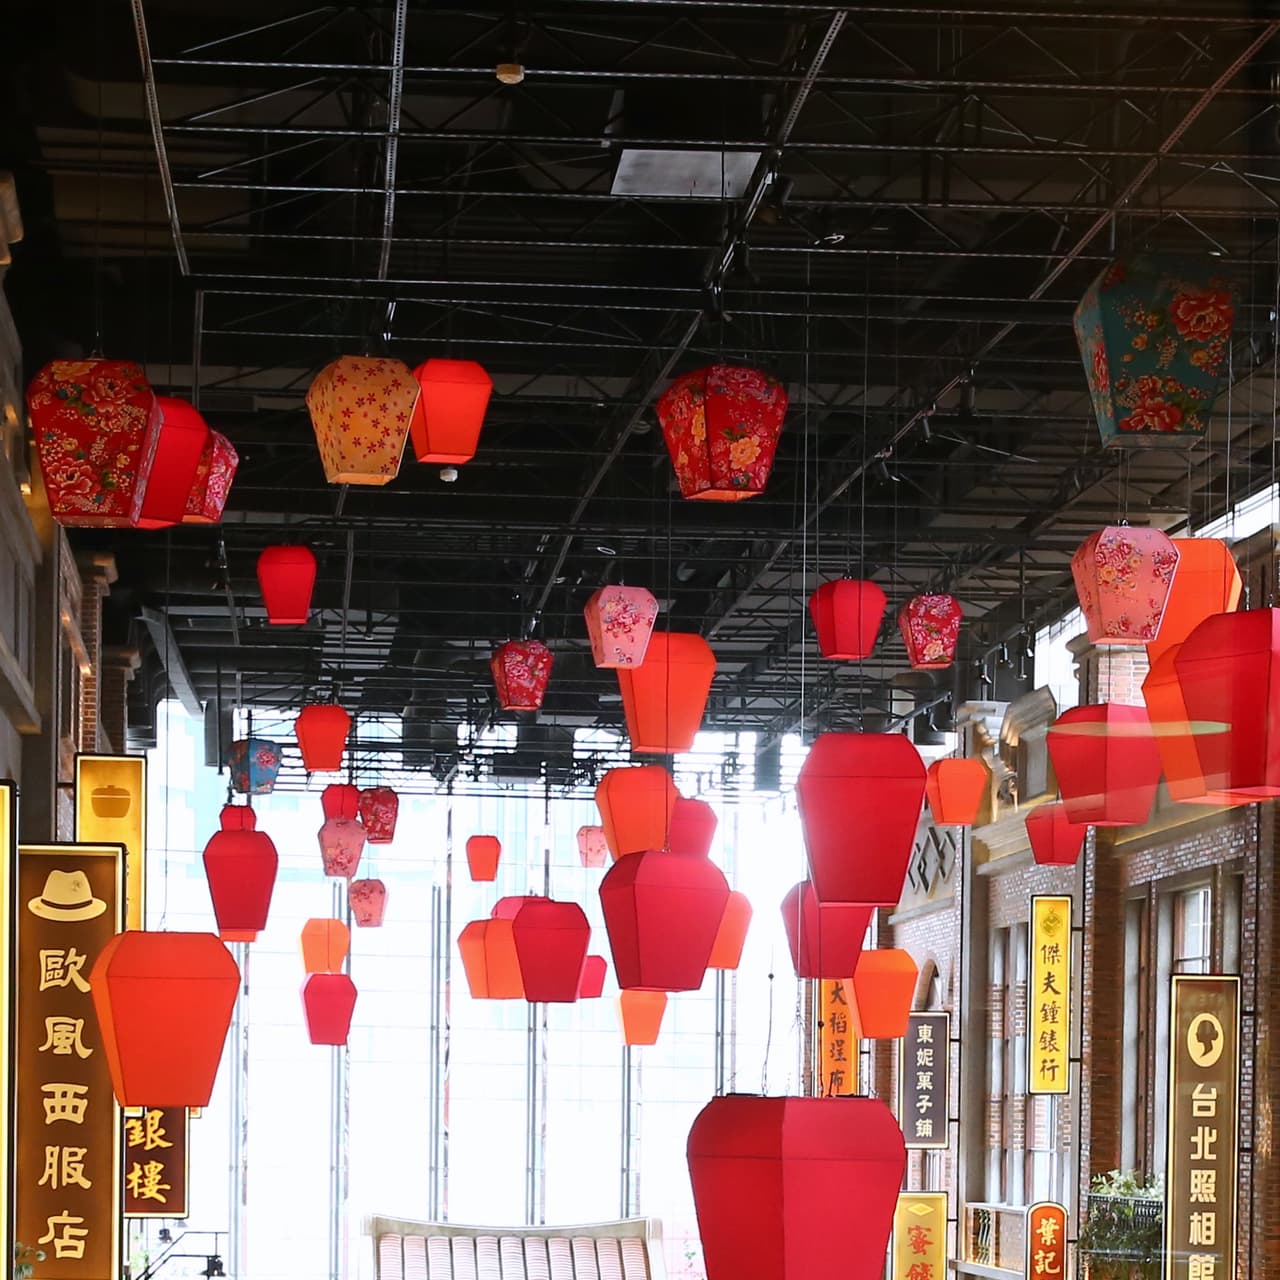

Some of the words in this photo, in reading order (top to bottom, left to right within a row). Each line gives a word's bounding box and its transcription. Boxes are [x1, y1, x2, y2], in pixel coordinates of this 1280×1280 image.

[38, 947, 93, 1259] 歐風西服店
[125, 1109, 173, 1203] 銀樓
